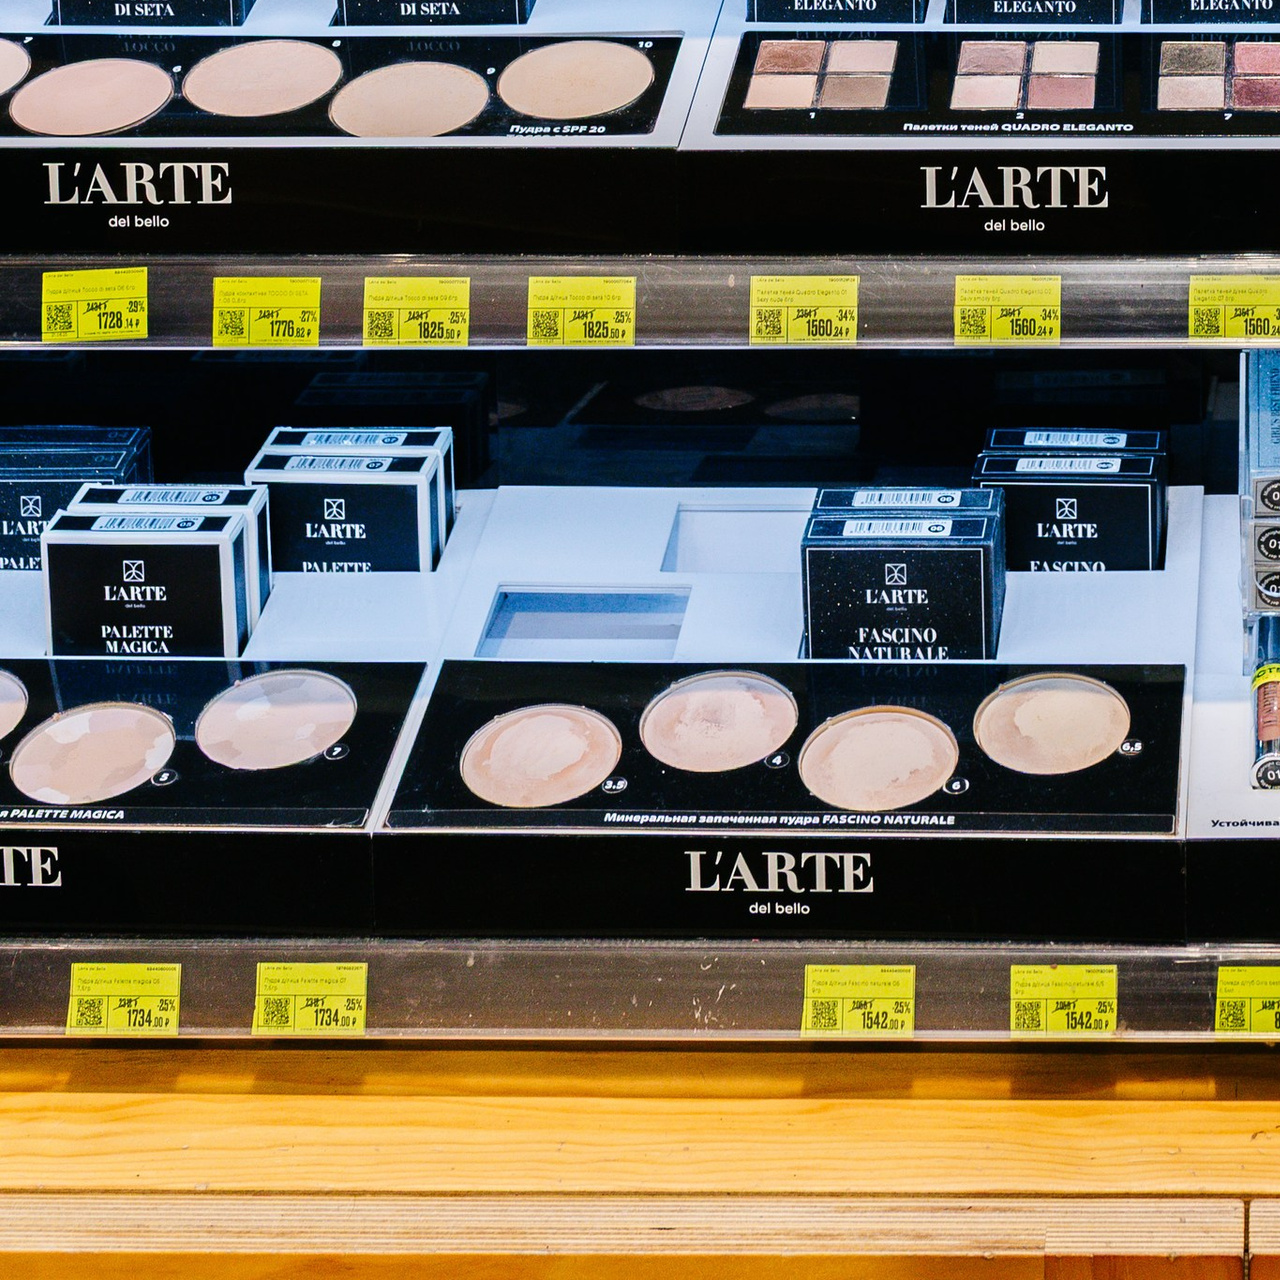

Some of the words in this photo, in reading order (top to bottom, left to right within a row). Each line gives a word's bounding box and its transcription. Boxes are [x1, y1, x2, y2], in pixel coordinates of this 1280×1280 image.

[401, 3, 416, 15] DI
[420, 2, 460, 15] SETA
[994, 0, 1076, 13] ELEGANTO
[510, 125, 551, 134] Пудра
[562, 125, 587, 133] SPF
[903, 123, 958, 131] Палетки
[960, 123, 999, 131] теней
[1001, 123, 1060, 131] QUADRO
[42, 163, 232, 205] L'ARTE
[920, 166, 1108, 209] L'ARTE
[984, 219, 1005, 231] del
[1011, 219, 1045, 231] bello
[101, 625, 173, 638] PALETTE
[859, 628, 937, 645] FASCINO
[106, 640, 169, 653] MAGICA
[10, 809, 69, 818] PALETTE
[70, 810, 124, 819] MAGICA
[604, 813, 697, 824] Минеральная
[779, 816, 820, 825] пудра
[822, 815, 881, 824] FASCINO
[884, 815, 955, 825] NATURALE
[684, 851, 873, 893] L'ARTE
